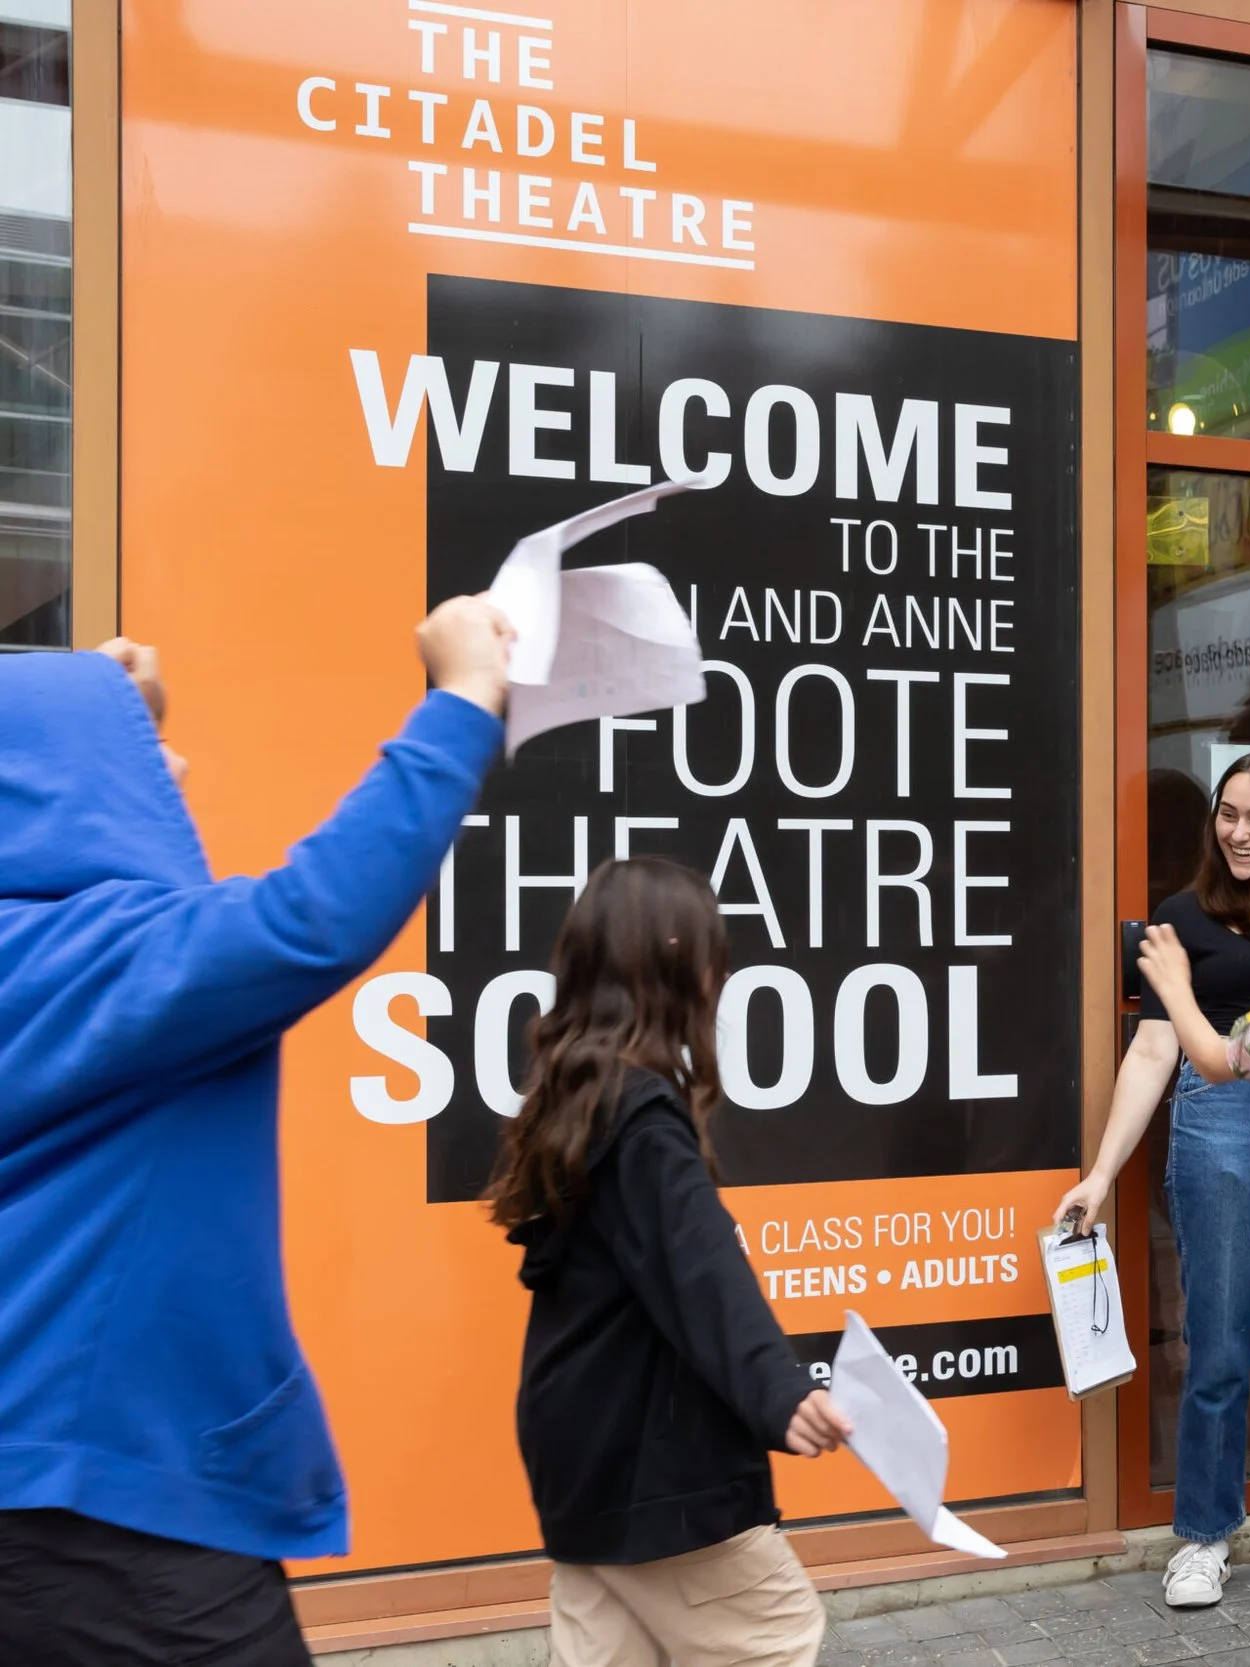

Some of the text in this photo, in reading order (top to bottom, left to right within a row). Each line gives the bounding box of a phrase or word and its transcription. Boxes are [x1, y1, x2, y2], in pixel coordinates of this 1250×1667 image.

[408, 19, 554, 90] THE
[297, 76, 657, 172] CITADEL
[408, 160, 755, 252] THEATRE
[348, 348, 1012, 511] WELCOME
[829, 517, 1015, 582] TO THE
[719, 586, 843, 645] AND
[862, 593, 1015, 653] ANNE
[600, 660, 1013, 799] FOOTE
[350, 964, 1018, 1125] SCOOL
[761, 1217, 863, 1255] CLASS
[874, 1213, 931, 1247] FOR
[941, 1207, 1015, 1242] YOU!
[763, 1264, 867, 1300] TEENS
[900, 1253, 1018, 1290] ADULTS
